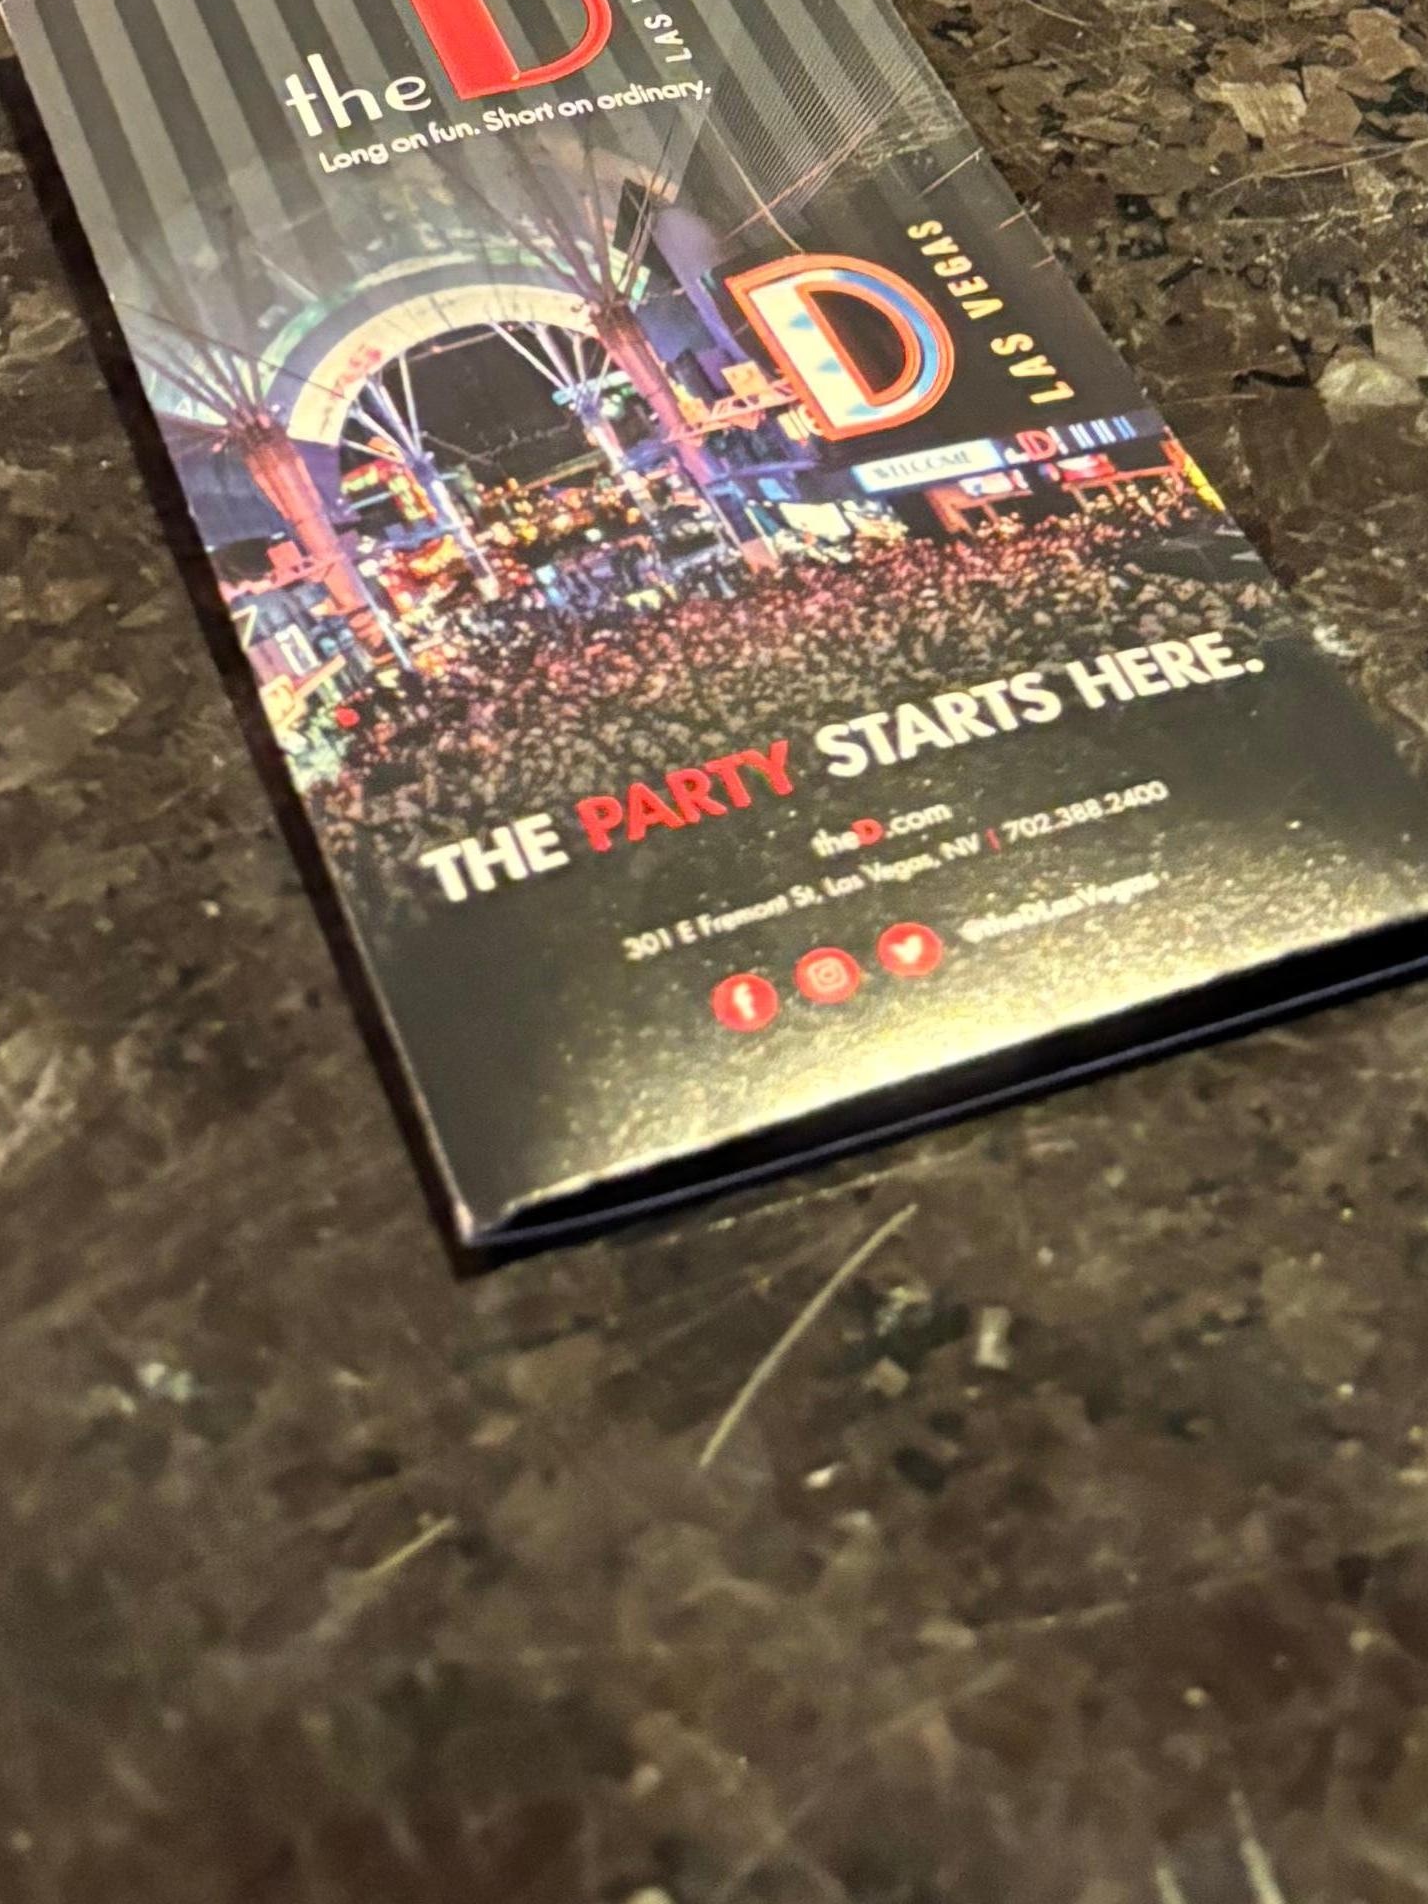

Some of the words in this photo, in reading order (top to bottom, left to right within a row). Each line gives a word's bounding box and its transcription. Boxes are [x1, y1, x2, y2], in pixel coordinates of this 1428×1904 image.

[643, 12, 693, 63] LAS
[285, 53, 432, 137] the
[319, 141, 389, 173] Long
[391, 130, 429, 155] on
[428, 121, 480, 145] fun.
[482, 101, 555, 133] Short
[559, 97, 595, 119] on
[597, 78, 712, 112] ordinary.
[907, 219, 1004, 320] VEGAS
[724, 253, 954, 441] D
[990, 332, 1075, 404] LAS
[420, 814, 570, 903] THE
[575, 740, 794, 854] PARTY
[813, 672, 1062, 778] STARTS
[1067, 631, 1265, 711] HERE.
[622, 928, 673, 960] 301
[675, 920, 697, 944] E
[822, 874, 864, 897] Las
[939, 832, 980, 860] NV
[1001, 780, 1170, 842] 702.388.2400
[811, 801, 954, 857] theD.com
